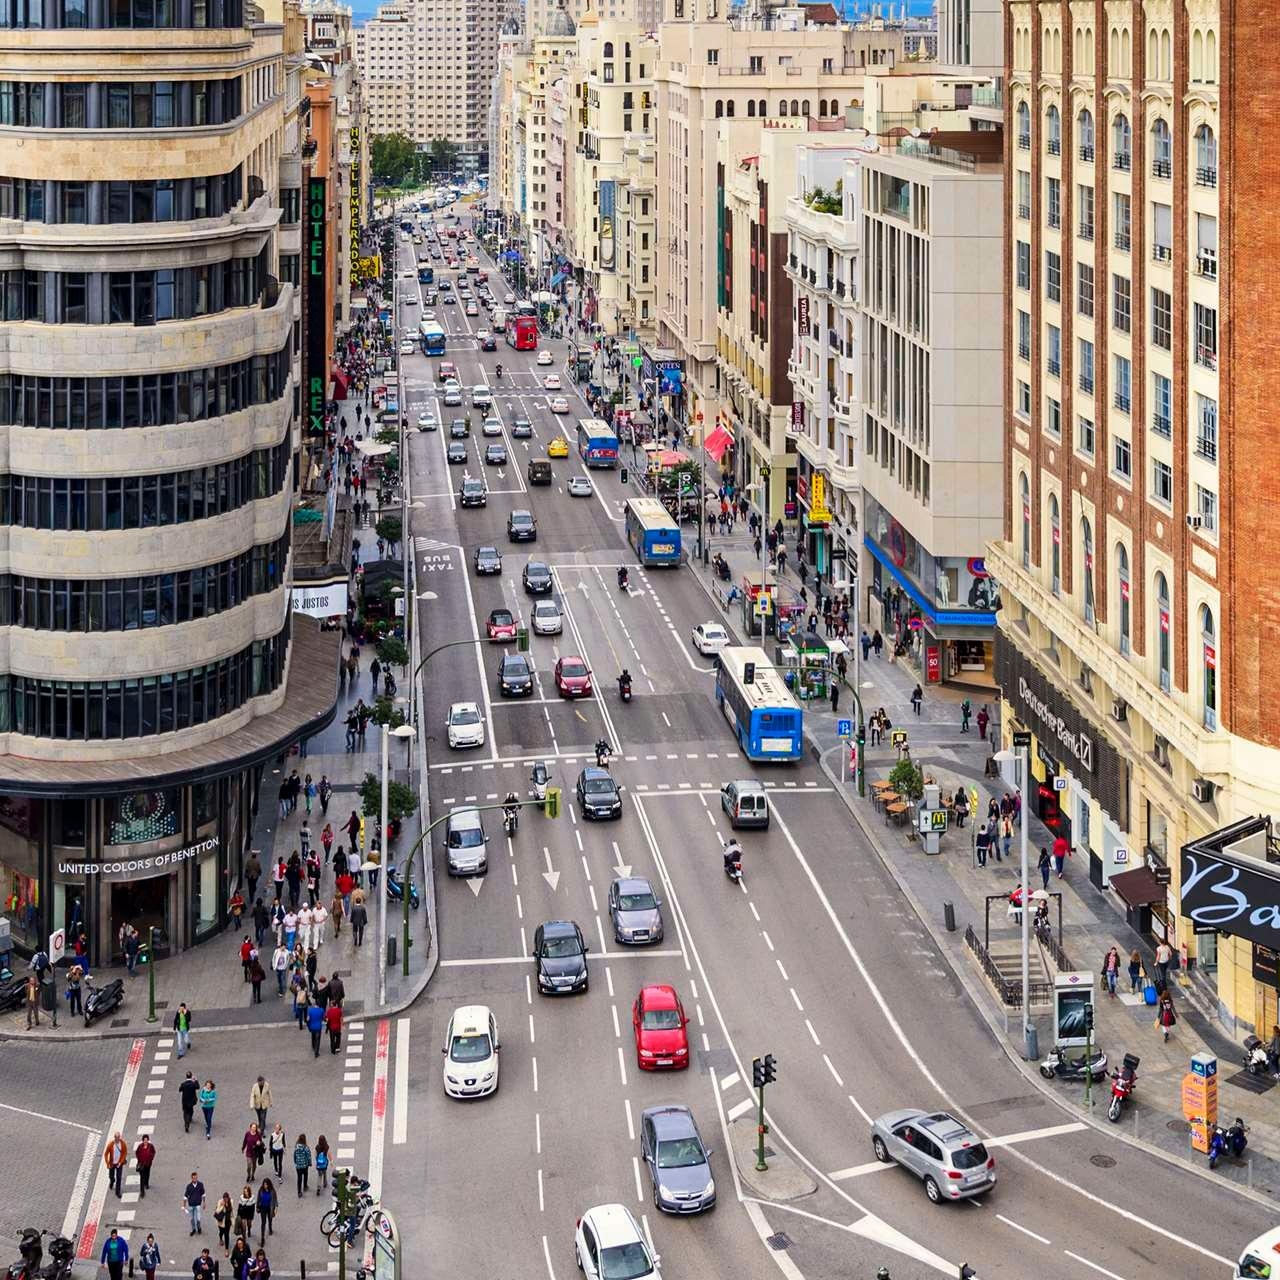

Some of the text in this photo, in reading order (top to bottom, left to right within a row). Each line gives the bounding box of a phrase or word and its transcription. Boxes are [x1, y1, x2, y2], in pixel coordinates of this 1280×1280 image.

[351, 127, 360, 282] HOTEL EMPERADOR
[310, 183, 323, 430] HOTEL REX
[422, 563, 454, 572] TAXI
[423, 554, 451, 562] BUS
[301, 596, 329, 610] JUSTOS
[1019, 676, 1056, 732] Deutsche
[1057, 717, 1081, 759] Bank
[58, 837, 220, 874] UNITED COLORS OF BENETTON
